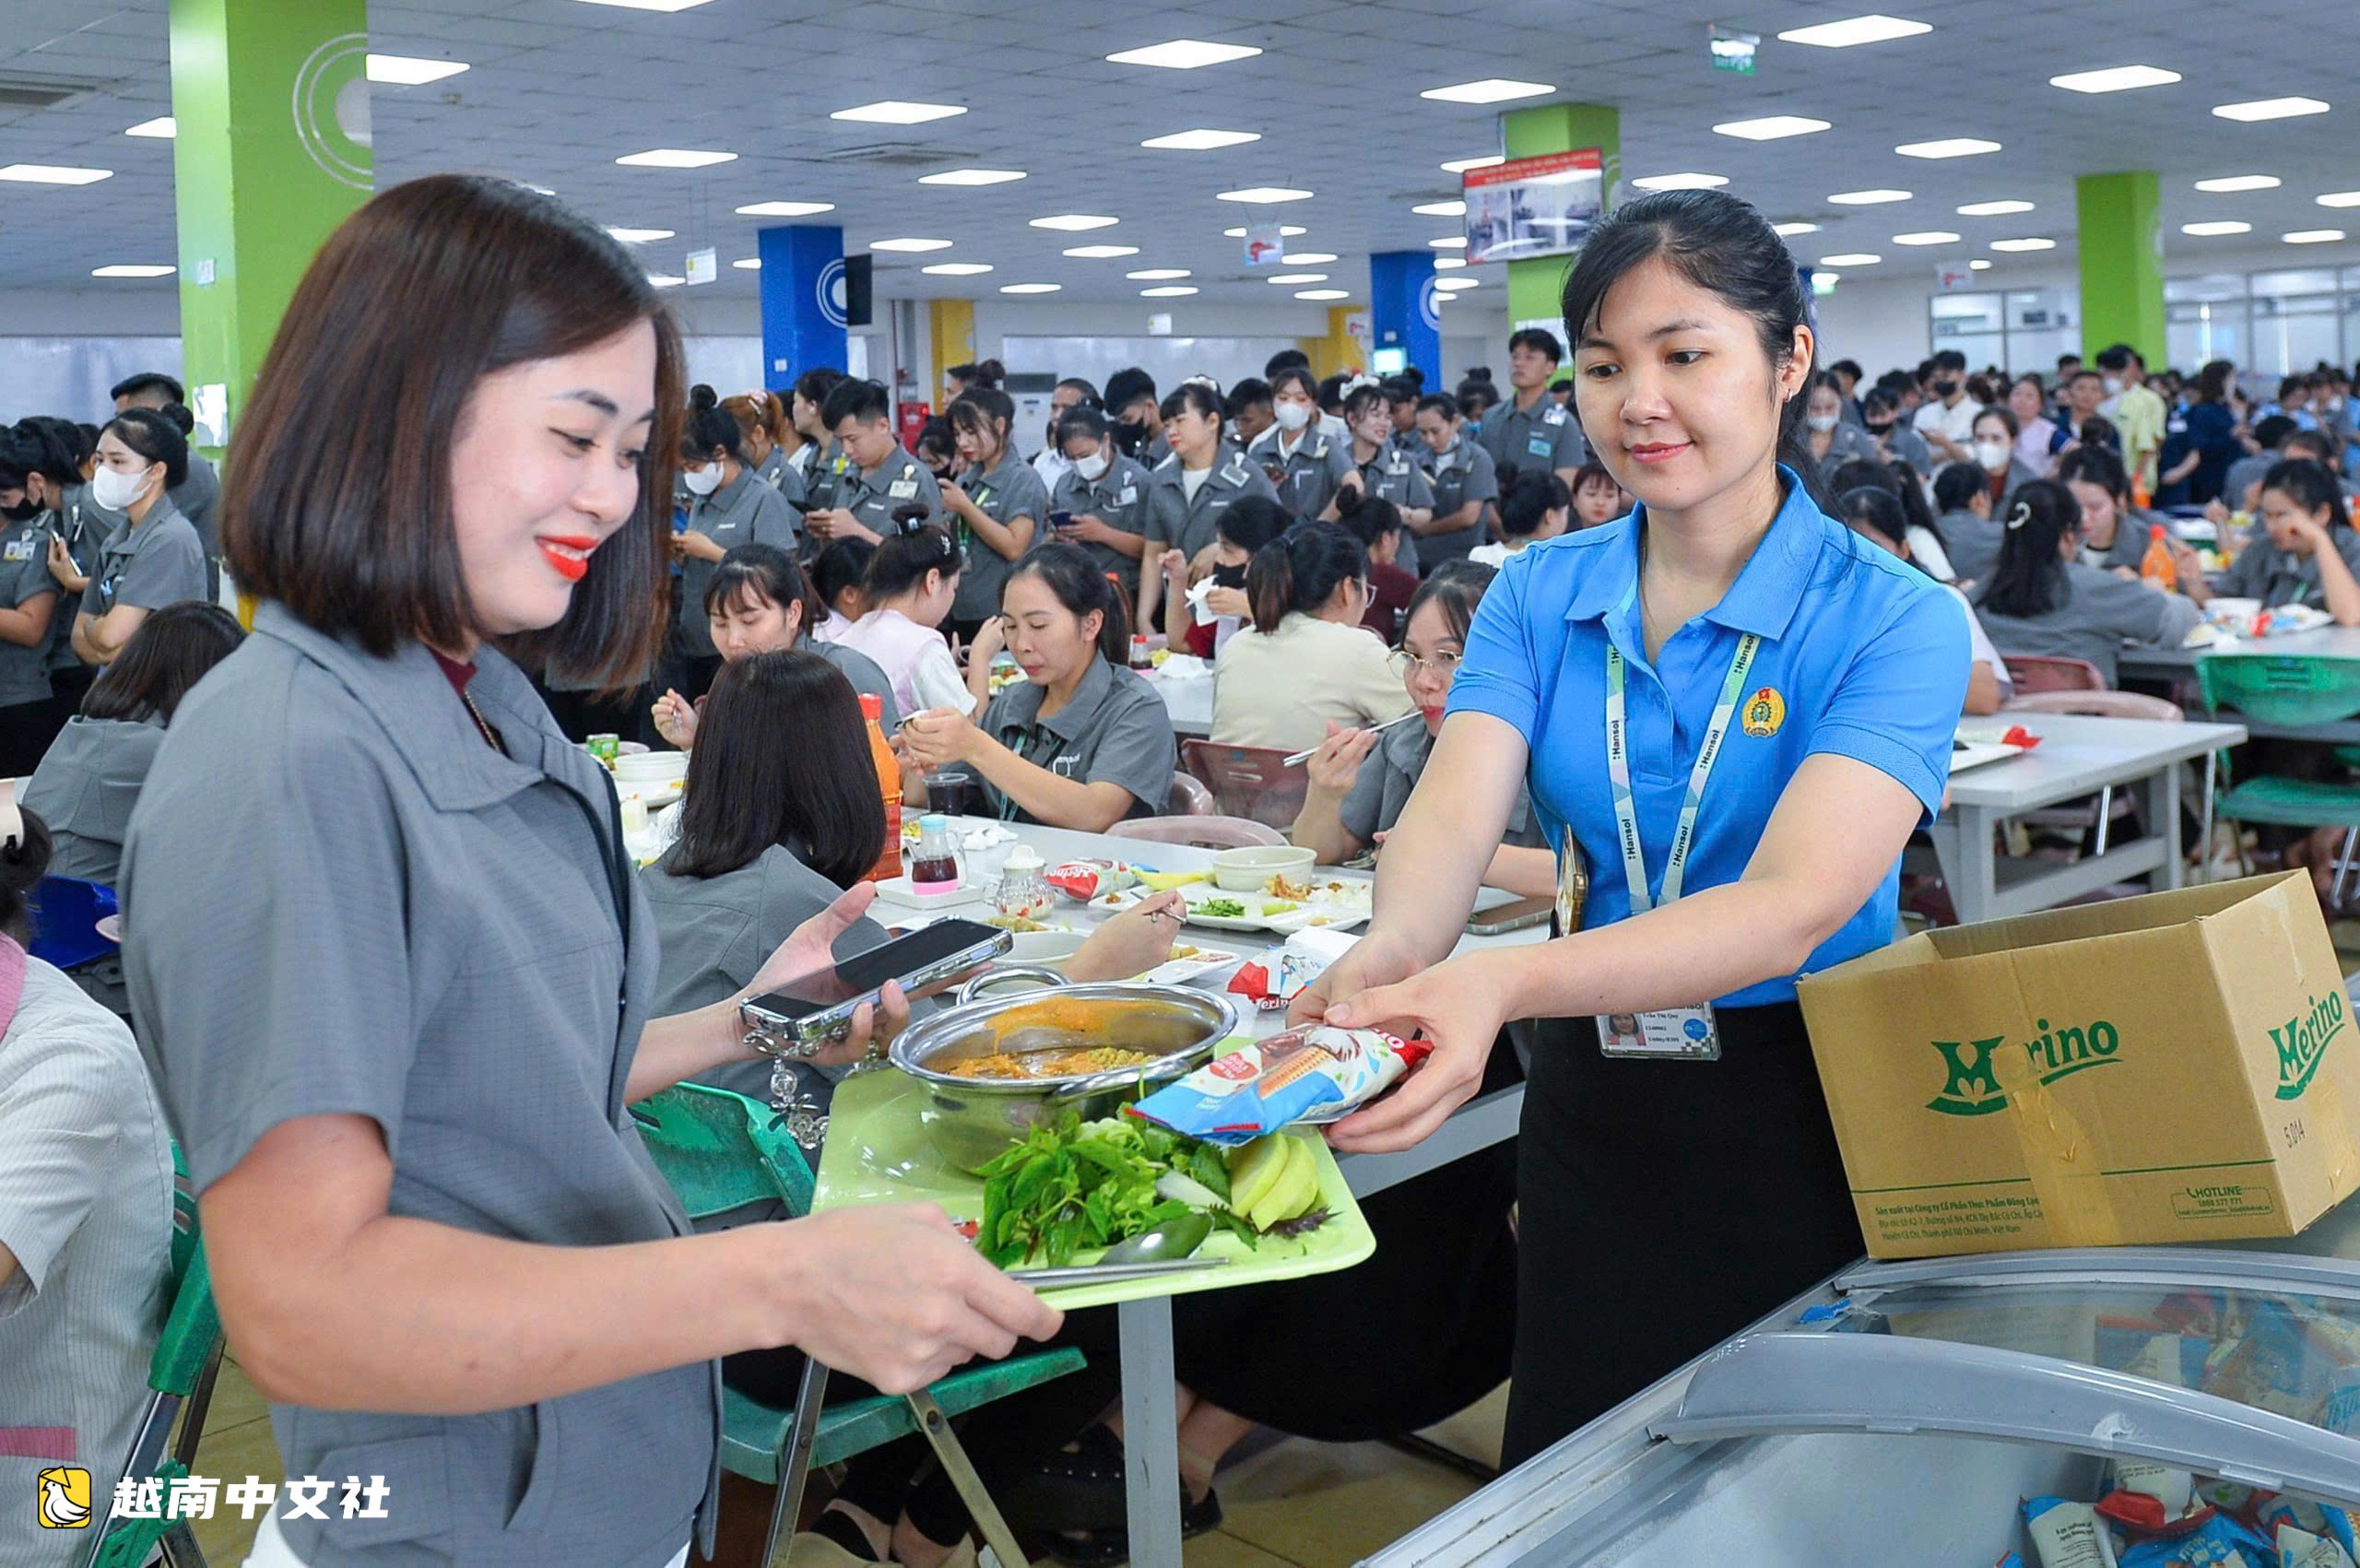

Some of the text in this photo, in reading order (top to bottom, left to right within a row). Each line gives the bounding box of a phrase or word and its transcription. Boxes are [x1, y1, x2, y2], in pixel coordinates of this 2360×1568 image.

[1930, 1019, 2119, 1096] Mrino
[2267, 991, 2342, 1081] Merino
[2195, 1185, 2242, 1197] HOTLINE
